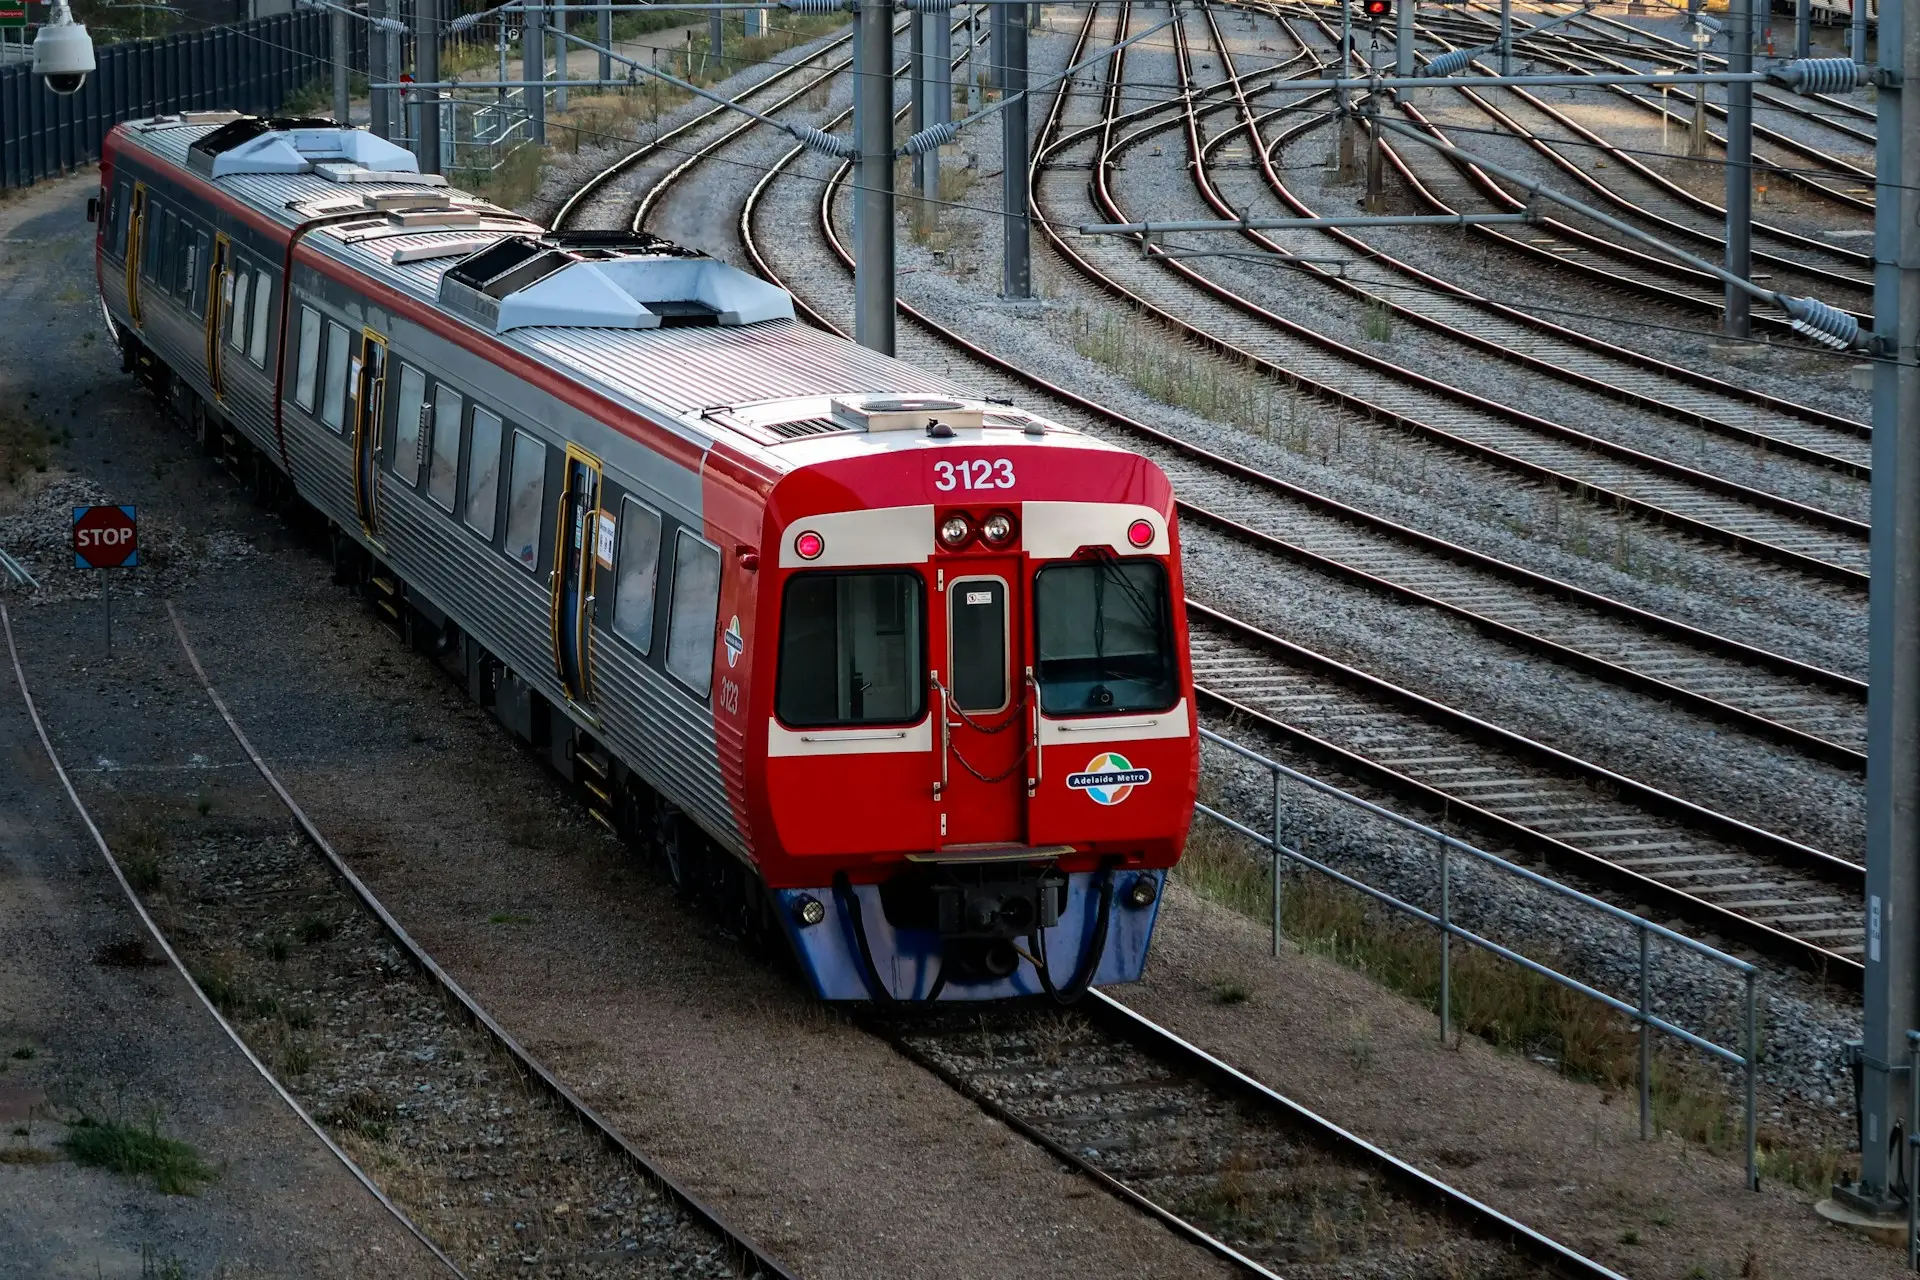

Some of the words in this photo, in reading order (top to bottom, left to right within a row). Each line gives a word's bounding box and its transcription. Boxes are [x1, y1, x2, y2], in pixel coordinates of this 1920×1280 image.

[510, 30, 518, 39] P
[1370, 39, 1379, 50] A
[934, 458, 1016, 491] 3123
[77, 527, 133, 547] STOP
[720, 675, 739, 716] 3123
[1073, 775, 1114, 786] Adelaide
[1117, 773, 1145, 783] Metro
